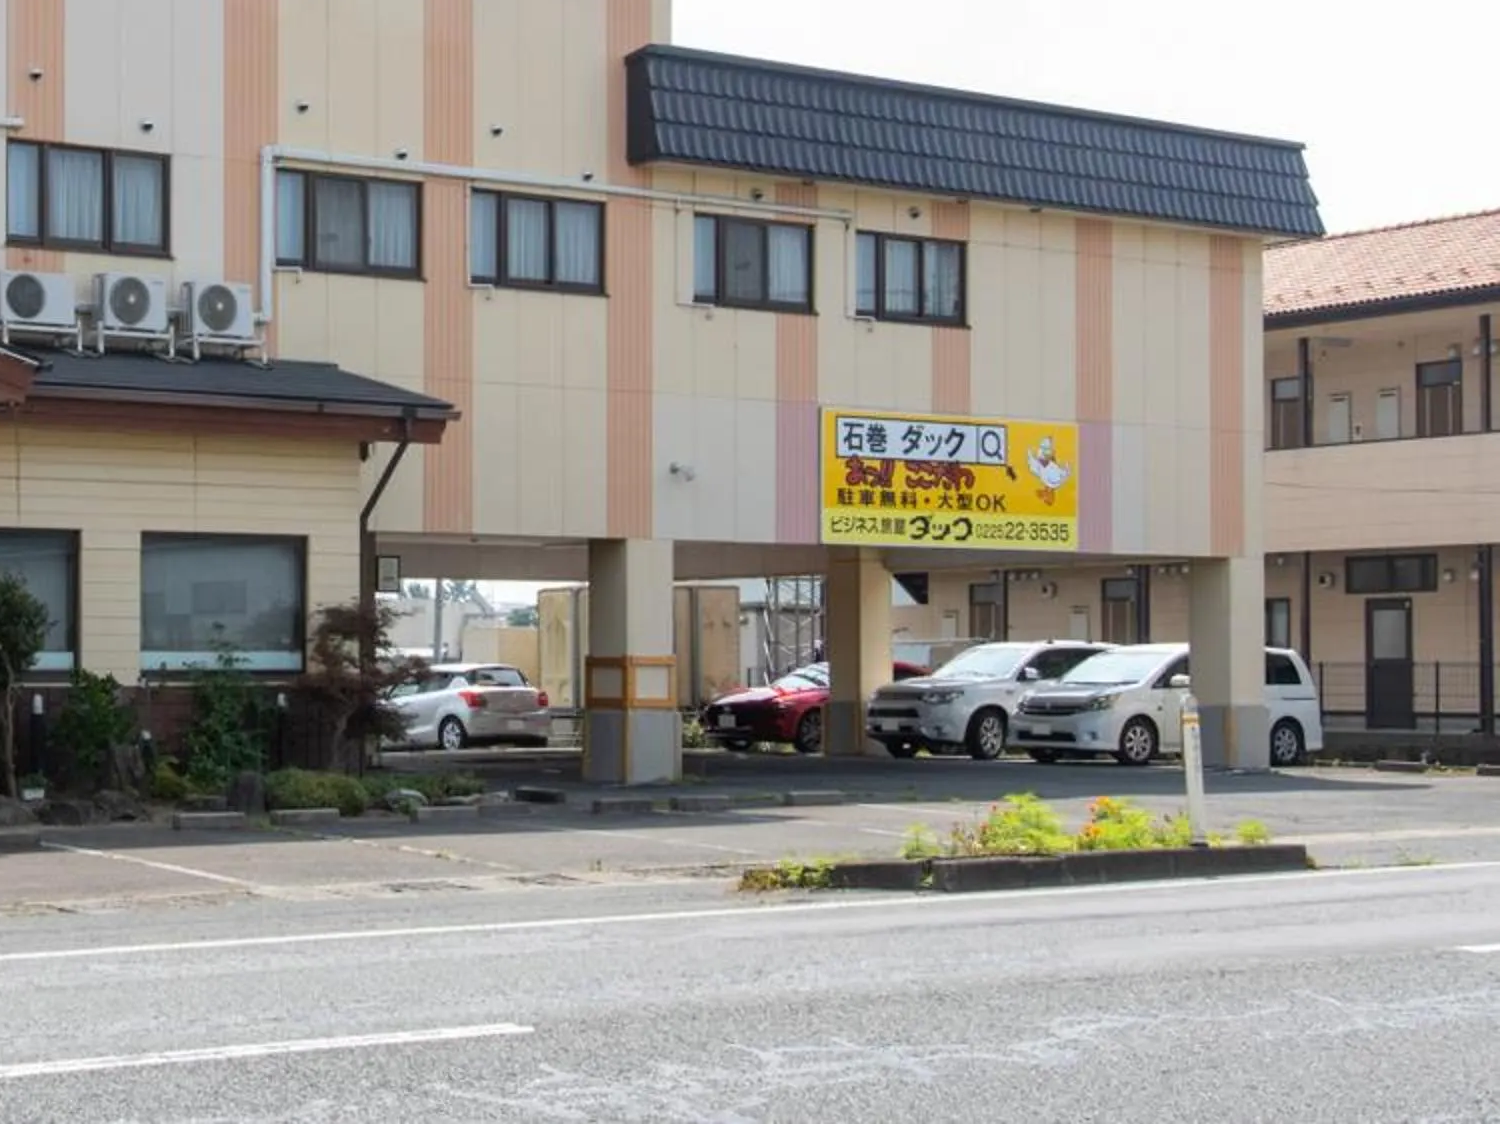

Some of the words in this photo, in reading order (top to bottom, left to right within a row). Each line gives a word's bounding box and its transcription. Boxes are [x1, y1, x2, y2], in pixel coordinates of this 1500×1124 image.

[842, 422, 888, 454] 石巻
[901, 425, 966, 458] ダック
